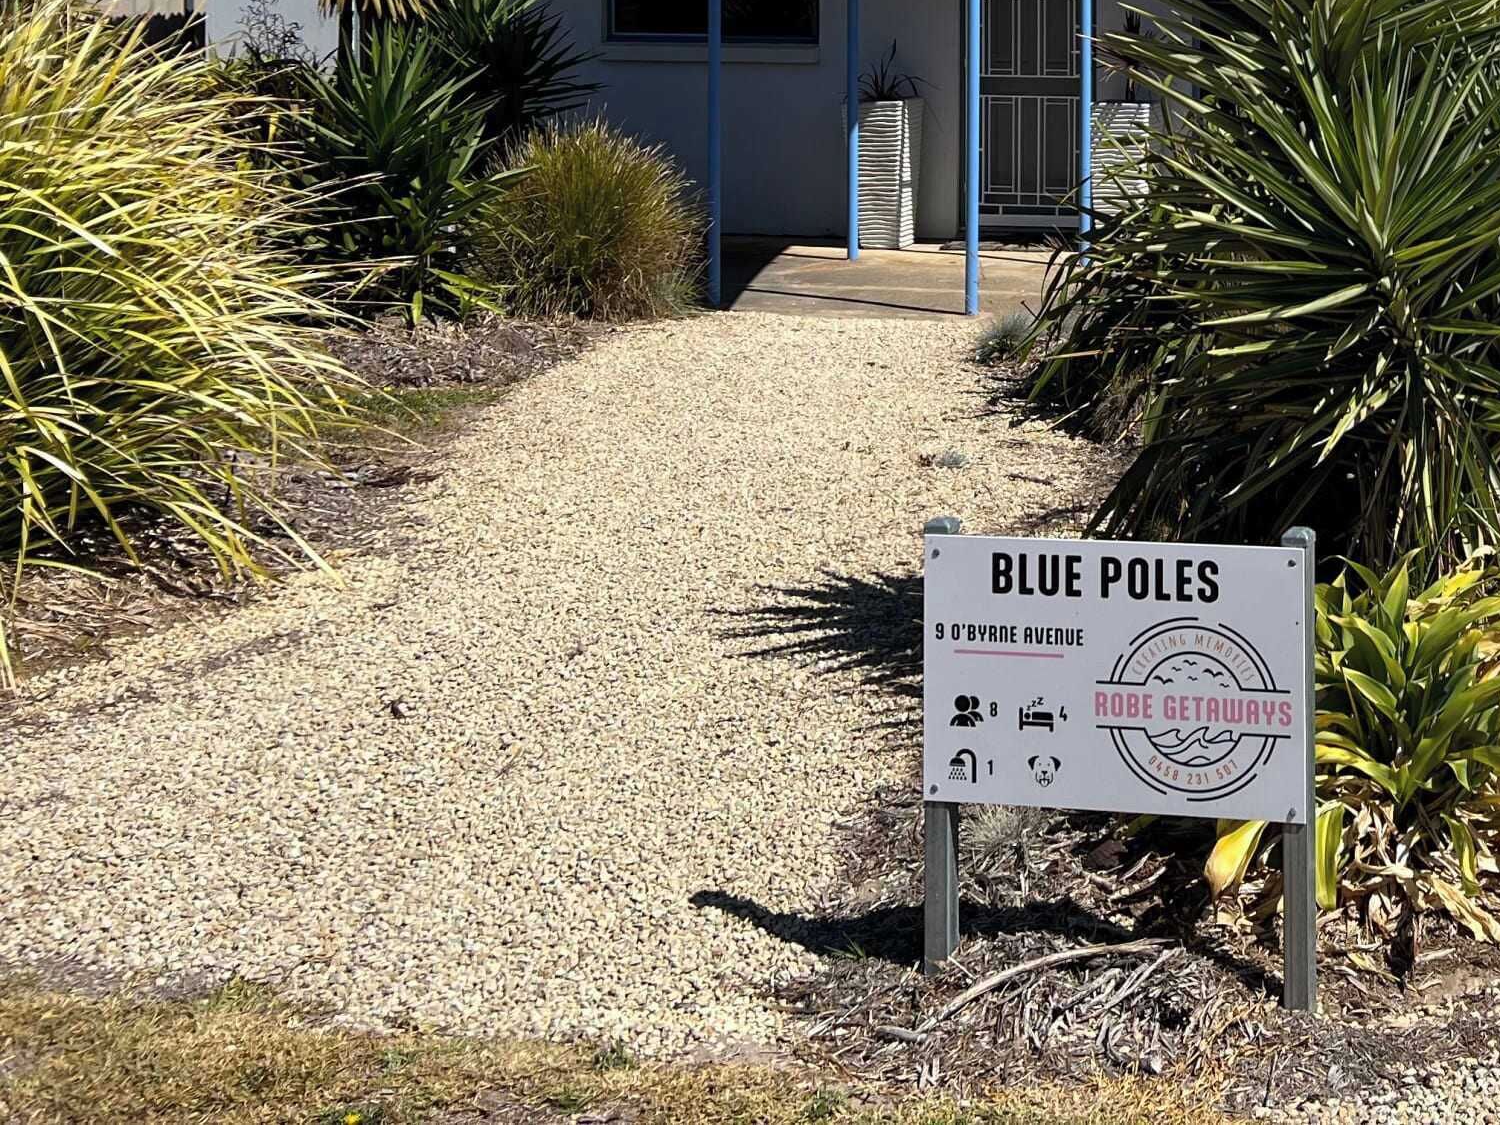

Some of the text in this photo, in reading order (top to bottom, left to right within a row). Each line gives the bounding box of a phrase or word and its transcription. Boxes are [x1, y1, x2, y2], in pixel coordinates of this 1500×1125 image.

[992, 552, 1219, 603] BLUE POLES
[935, 623, 1084, 646] 9 O'BYRNE AVENUE
[1132, 634, 1255, 682] CREATING MEMORIES
[989, 701, 998, 717] 8
[1059, 706, 1068, 721] 4
[1095, 691, 1292, 726] ROBE GETAWAYS
[986, 759, 993, 775] 1
